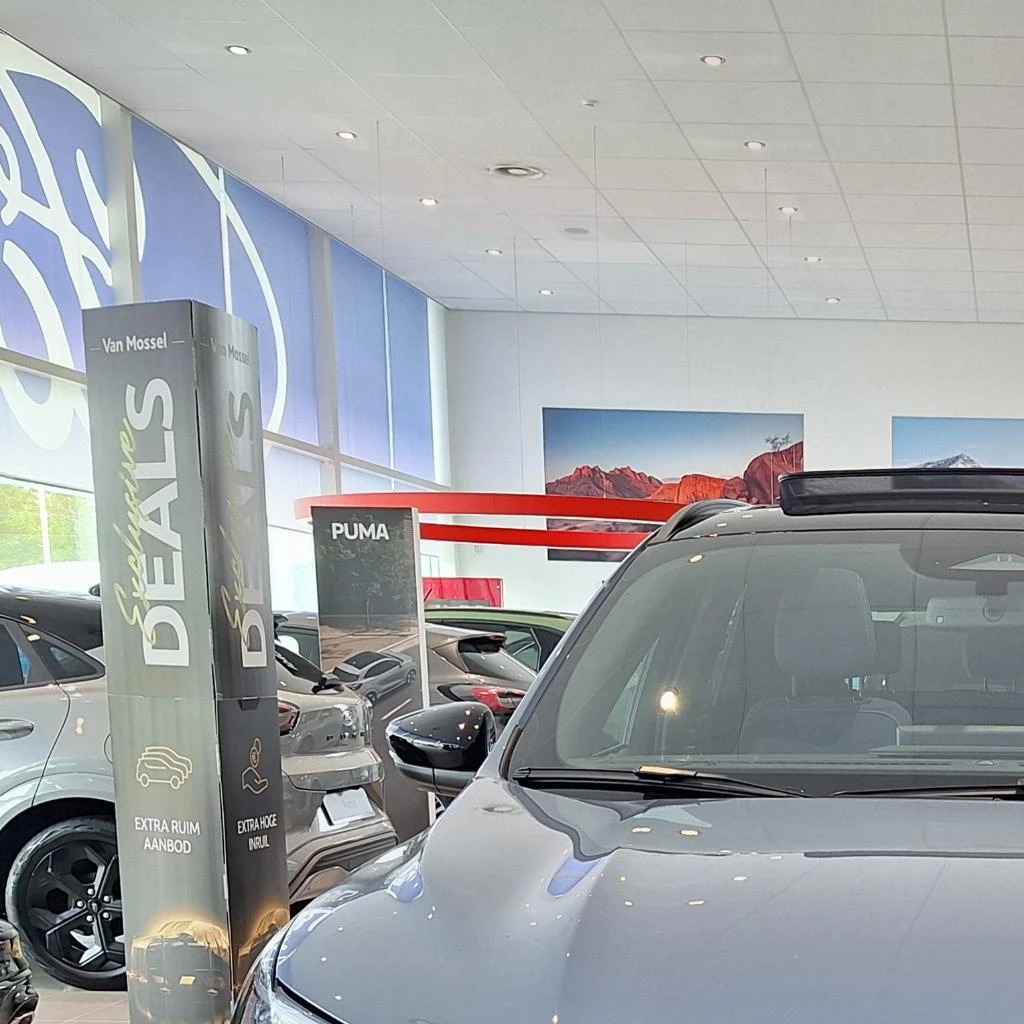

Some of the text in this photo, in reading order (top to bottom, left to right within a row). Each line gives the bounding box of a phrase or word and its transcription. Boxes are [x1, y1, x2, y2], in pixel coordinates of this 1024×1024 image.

[102, 332, 167, 353] Van Mossel
[113, 417, 157, 646] Exclusive
[125, 377, 190, 667] DEALS
[229, 391, 268, 668] DEALS
[331, 522, 390, 540] PUMA
[134, 816, 201, 836] EXTRA RUIM
[237, 813, 278, 834] EXTRA HOGE
[143, 837, 192, 854] AANBOD
